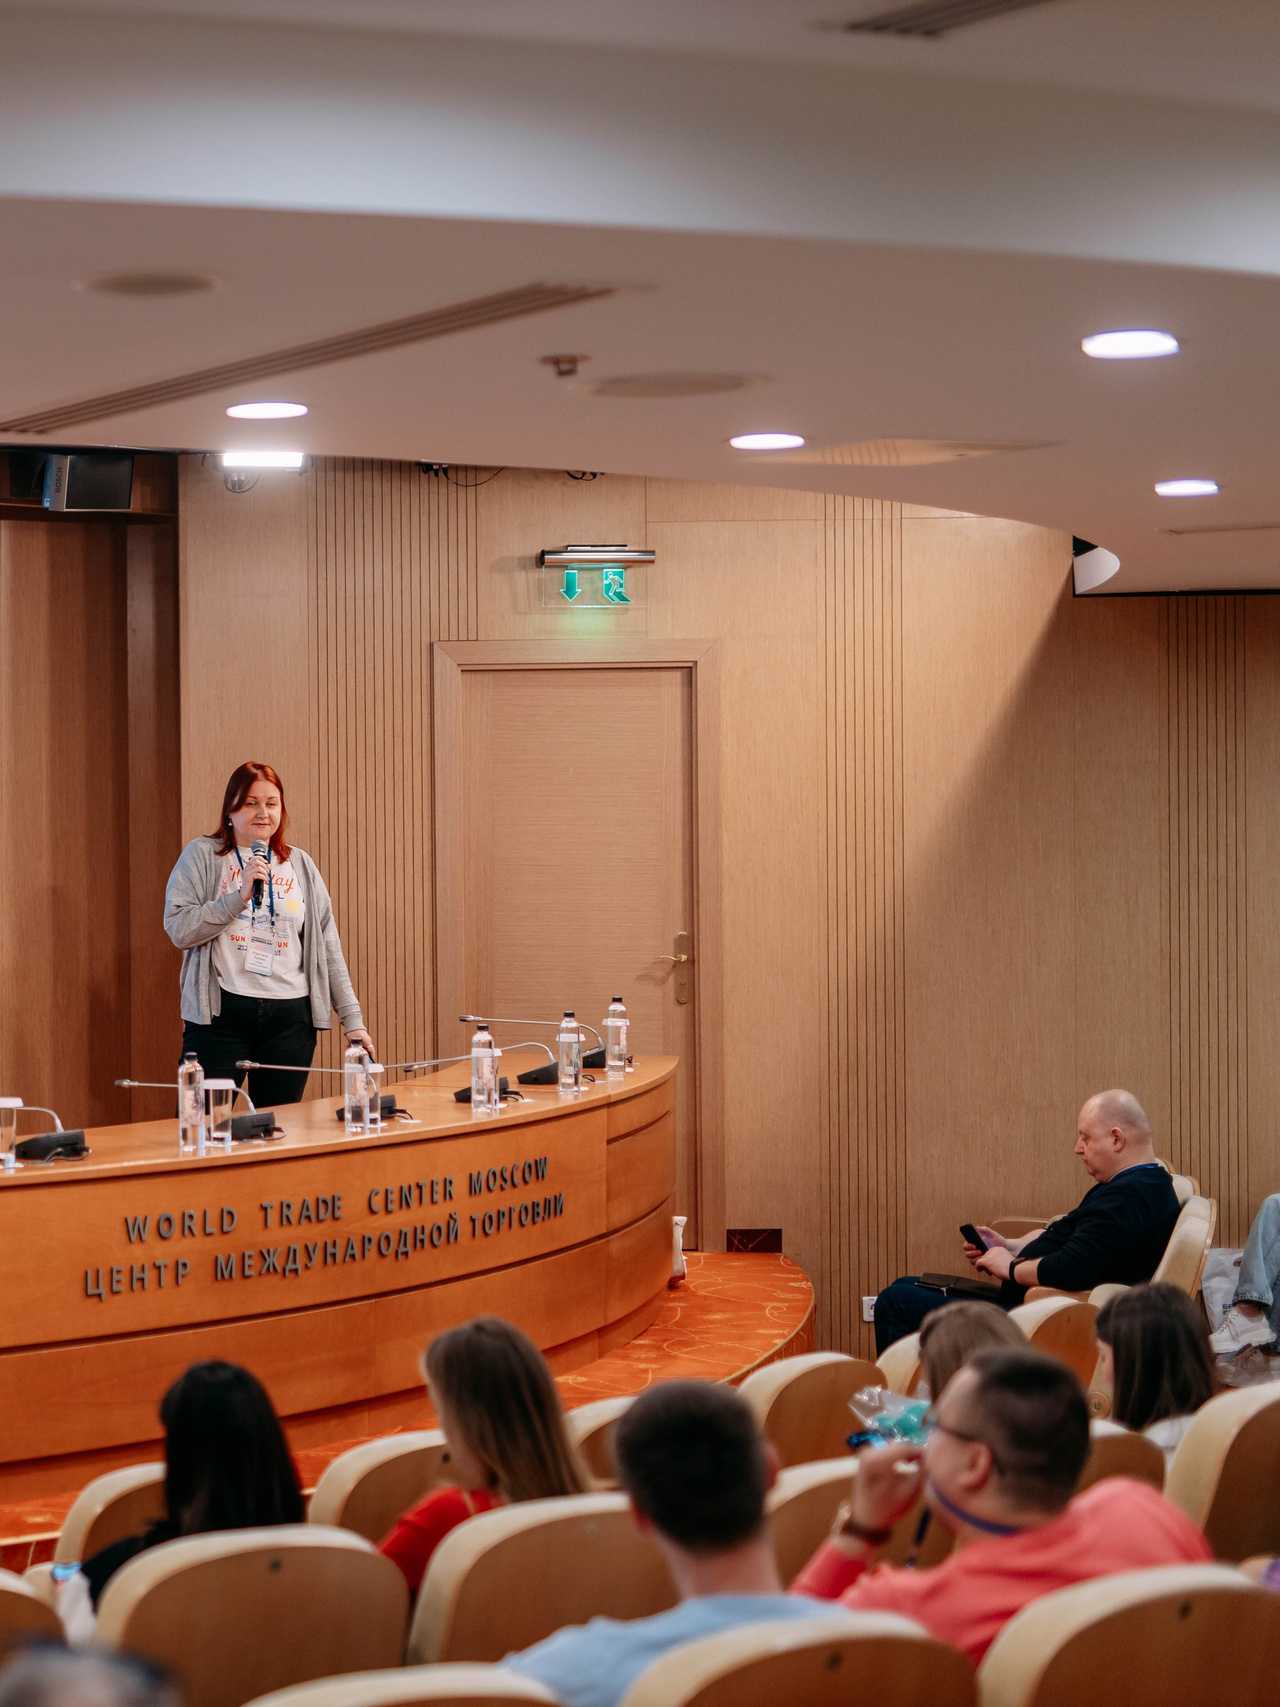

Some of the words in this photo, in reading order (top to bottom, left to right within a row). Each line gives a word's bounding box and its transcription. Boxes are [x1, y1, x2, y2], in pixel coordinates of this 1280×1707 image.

[230, 934, 246, 943] SUN
[125, 1206, 238, 1243] WORLD
[261, 1194, 345, 1227] TRADE
[369, 1177, 456, 1214] CENTER
[469, 1156, 549, 1196] MOSCOW
[85, 1257, 192, 1302] ЦЕНТР
[215, 1211, 461, 1282] МЕЖДУНАРОДНОЙ
[470, 1192, 566, 1239] ТОРГОВЛИ
